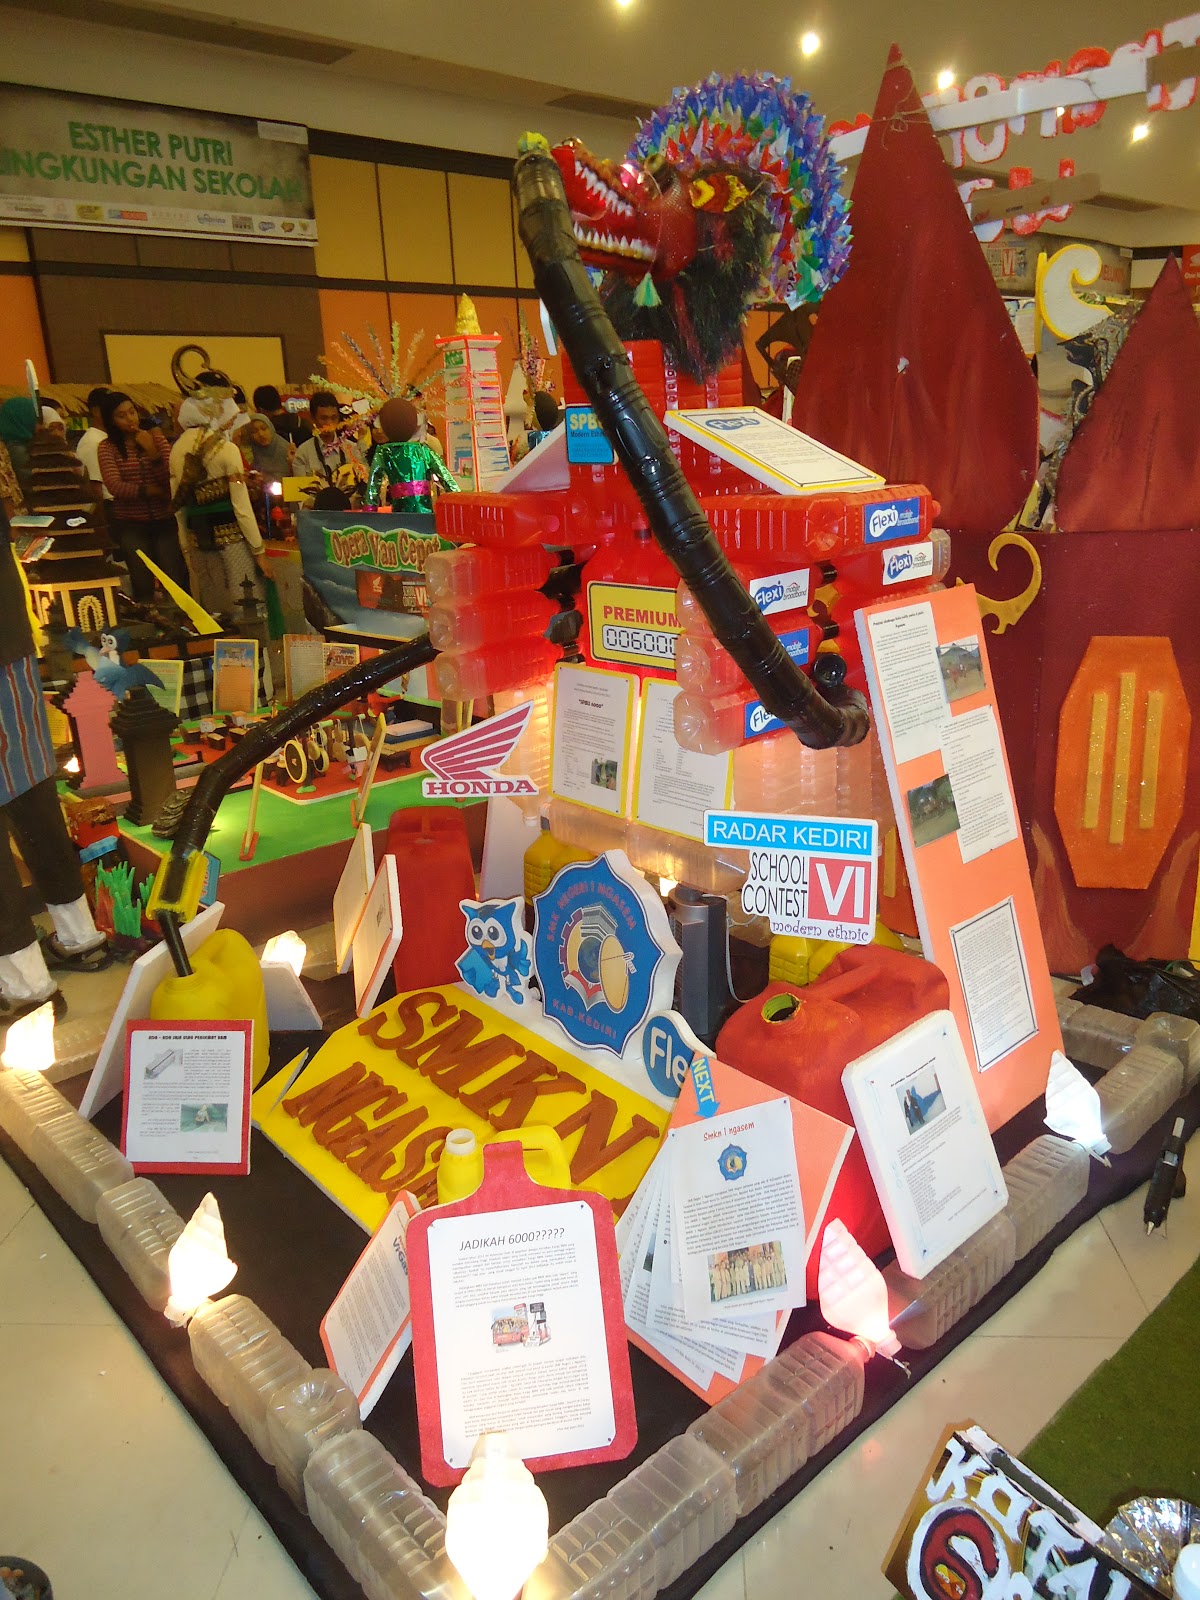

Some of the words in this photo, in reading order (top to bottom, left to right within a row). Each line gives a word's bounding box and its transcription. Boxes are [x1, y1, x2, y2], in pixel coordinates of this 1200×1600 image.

[68, 121, 163, 158] ESTHER
[169, 134, 234, 166] PUTRI
[193, 167, 303, 203] SEKOLAH
[570, 413, 603, 430] SPB
[712, 417, 755, 430] Flexi
[872, 504, 897, 532] Flexi
[330, 530, 370, 568] Opera
[367, 532, 398, 568] Van
[398, 529, 441, 574] Cepot
[890, 550, 912, 576] Flexi
[755, 581, 783, 605] Flexi
[603, 605, 682, 628] PREMIUM
[753, 710, 773, 728] Fle
[426, 780, 537, 795] HONDA
[713, 821, 787, 844] RADAR
[794, 827, 868, 850] KEDIRI
[751, 852, 808, 885] SCHOOL
[815, 863, 866, 919] VI
[547, 913, 560, 942] SMK
[597, 882, 637, 930] NGASEM
[743, 884, 808, 919] CONTEST
[772, 920, 822, 936] modern
[828, 925, 869, 942] ethnic
[650, 1027, 688, 1088] Fle
[357, 990, 661, 1185] SMKN
[692, 1058, 715, 1103] NEXT
[281, 1061, 439, 1210] NGAS
[703, 1130, 722, 1141] Smkn
[723, 1127, 727, 1135] 1
[728, 1121, 755, 1136] ngasem
[459, 1236, 505, 1251] JADIKAH
[508, 1227, 565, 1245] 6000?????
